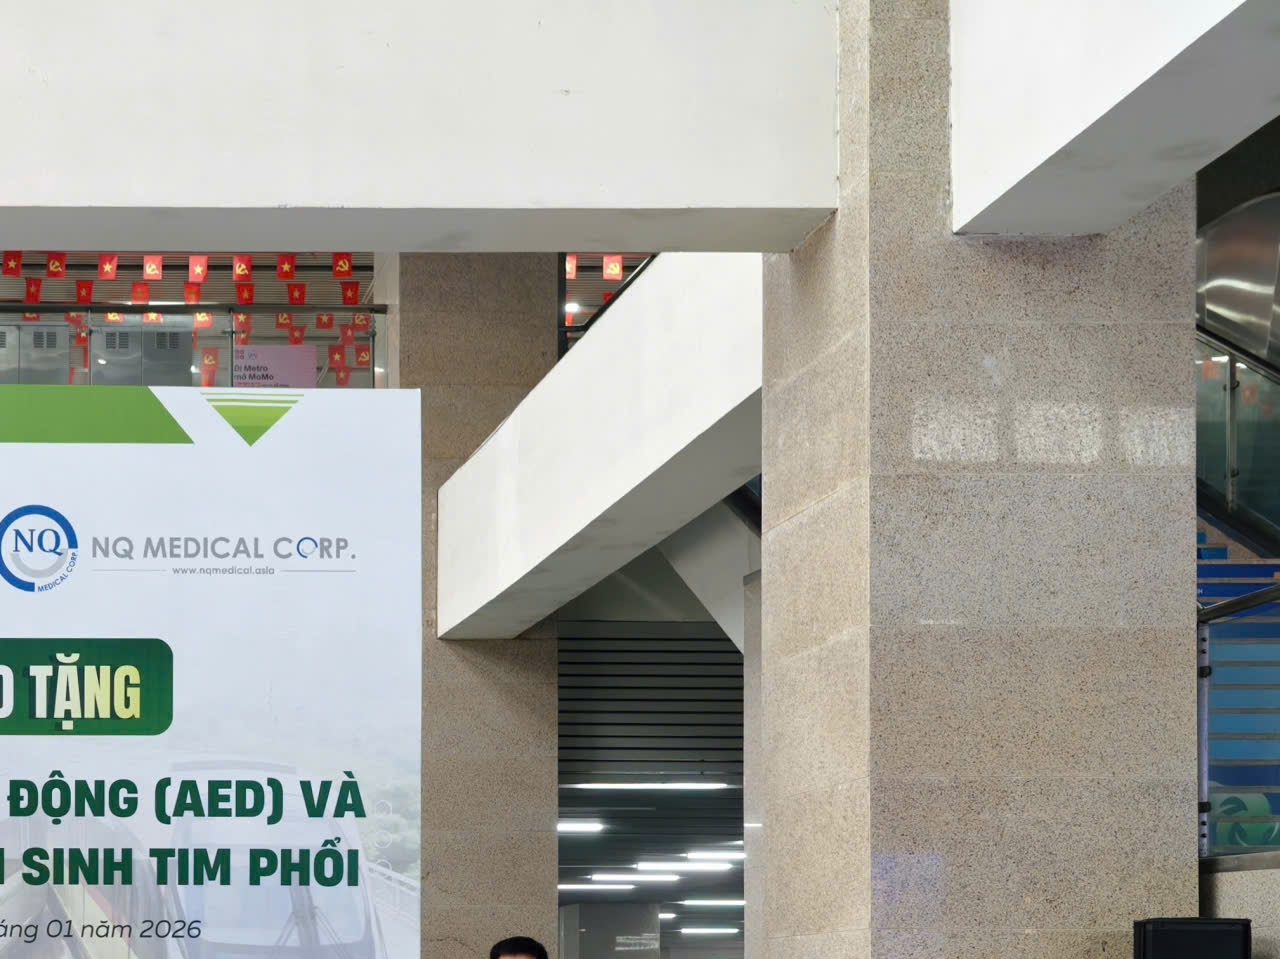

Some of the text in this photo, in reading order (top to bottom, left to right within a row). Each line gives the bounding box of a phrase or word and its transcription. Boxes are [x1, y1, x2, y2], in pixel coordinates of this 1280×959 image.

[243, 364, 268, 372] Metro
[248, 373, 274, 381] MoMo
[12, 528, 64, 556] NQ
[92, 536, 356, 560] NQ MEDICAL CORP.
[37, 572, 69, 593] MEDICAL
[172, 566, 275, 577] www.nqmedical.asia
[28, 652, 141, 731] TẶNG
[6, 769, 139, 825] ĐỘNG
[154, 777, 285, 825] (AED)
[298, 770, 367, 818] VÀ
[21, 846, 133, 886] SINH
[149, 847, 231, 886] TIM
[248, 836, 360, 887] PHỔI
[46, 919, 74, 938] 01
[80, 919, 133, 939] năm
[139, 919, 202, 939] 2026
